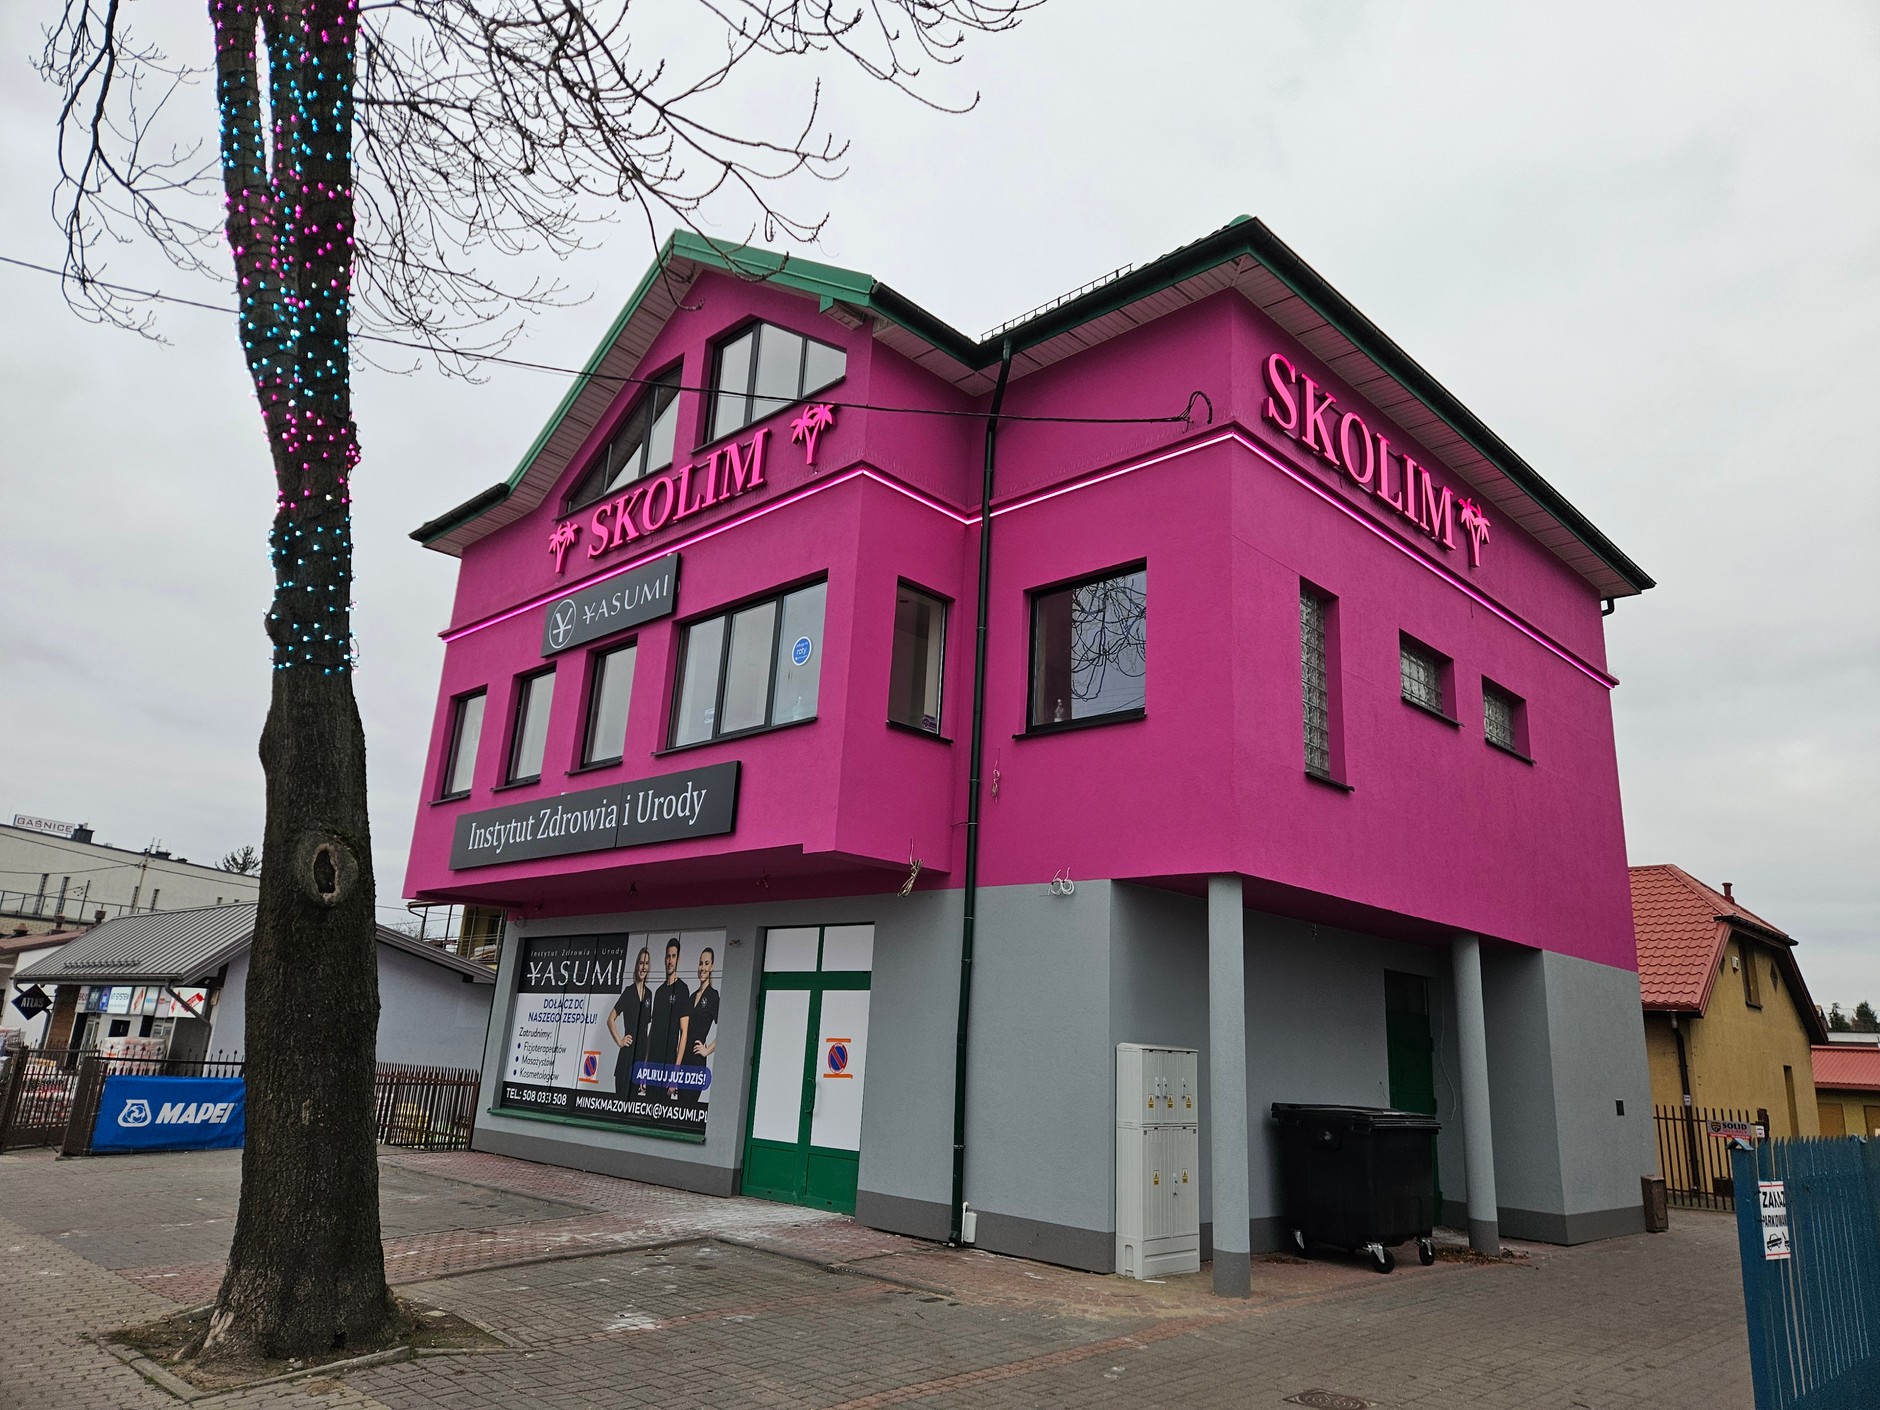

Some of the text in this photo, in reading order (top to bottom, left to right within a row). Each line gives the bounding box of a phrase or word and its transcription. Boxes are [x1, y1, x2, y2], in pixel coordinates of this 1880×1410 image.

[1263, 353, 1456, 550] SKOLIM
[588, 428, 772, 559] SKOLIM
[582, 574, 669, 625] YASUMI
[17, 817, 73, 833] GAŚNICE
[468, 781, 707, 853] Instytut Zdrowia i Urody
[531, 949, 558, 958] Instytut
[562, 948, 590, 956] Zdrowia
[601, 947, 624, 956] Urody
[526, 960, 623, 986] YASUMI
[20, 997, 44, 1009] ATLAS
[528, 1012, 560, 1023] NASZEGO
[519, 1027, 552, 1040] Zatrudnimy:
[523, 1042, 567, 1055] Fizjoterapeutów
[521, 1055, 554, 1068] Masażystów
[520, 1068, 560, 1082] Kosmetologów
[636, 1068, 707, 1086] APLIKUJ JUŻ DZIŚ!
[522, 1090, 536, 1101] 508
[552, 1094, 567, 1106] 508
[155, 1102, 235, 1124] MAPEI
[1722, 1122, 1747, 1130] SOLID
[1762, 1191, 1786, 1208] ZAKAZ
